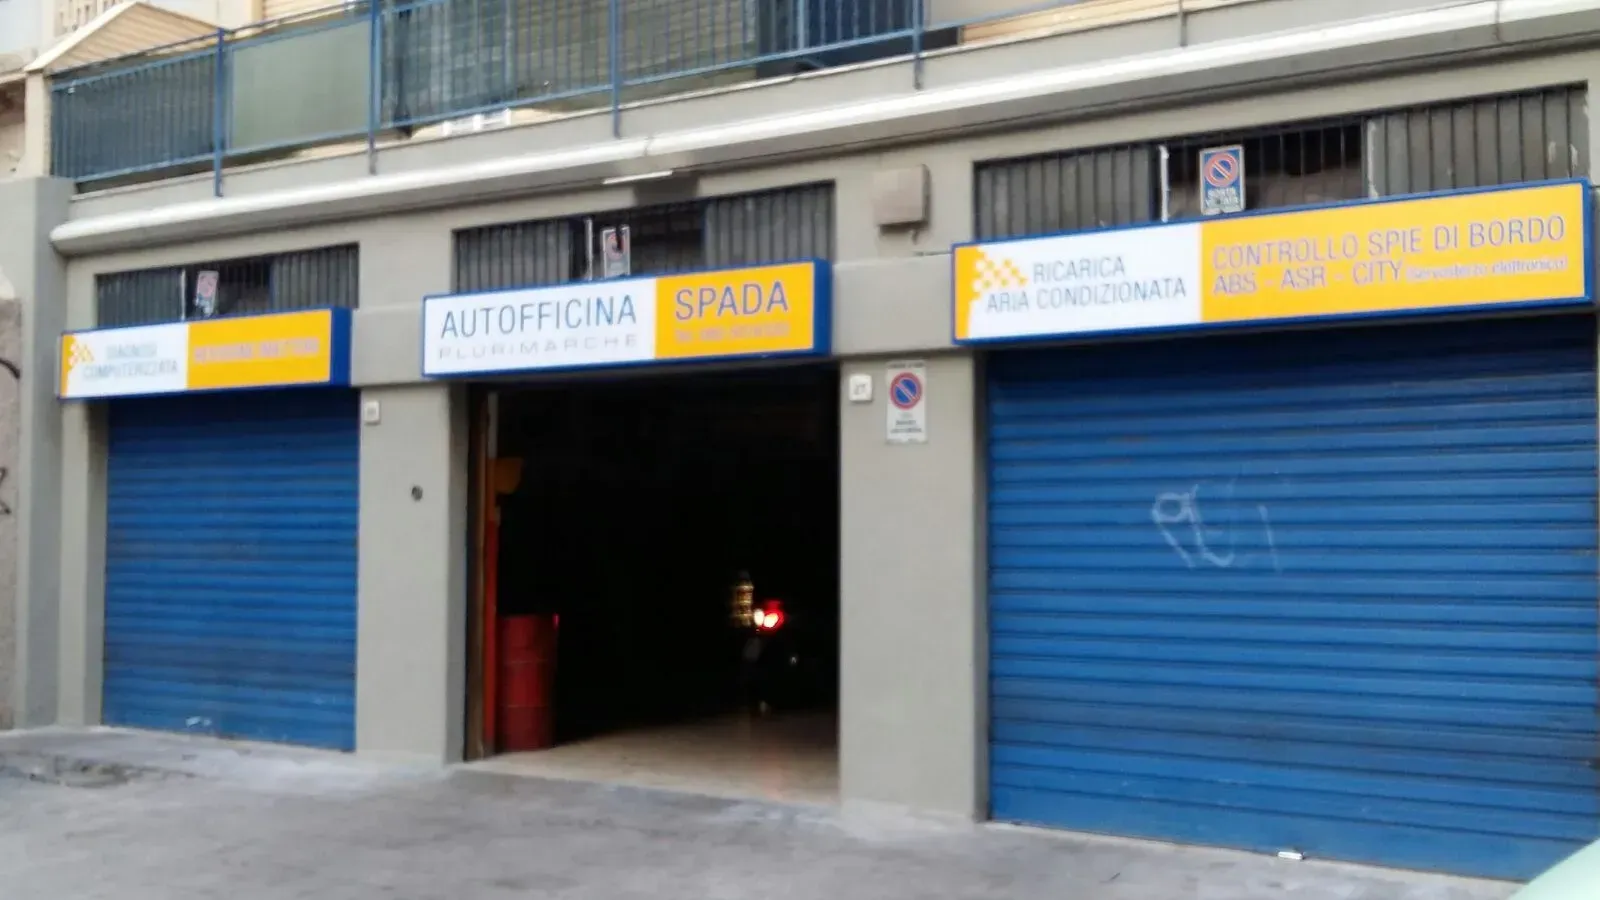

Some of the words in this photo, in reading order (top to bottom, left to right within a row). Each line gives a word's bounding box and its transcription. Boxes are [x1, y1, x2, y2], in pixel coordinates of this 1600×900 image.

[1212, 234, 1359, 270] CONTROLLO
[1367, 228, 1421, 257] SPIE
[1433, 223, 1458, 251] DI
[1469, 215, 1566, 247] BORDO
[1033, 255, 1126, 284] RICARICA
[1213, 271, 1257, 296] ABS
[1280, 266, 1326, 290] ASR
[1352, 260, 1404, 286] CITY
[674, 281, 789, 321] SPADA
[986, 290, 1029, 313] ARIA
[1035, 277, 1187, 310] CONDIZIONATA
[440, 294, 637, 339] AUTOFFICINA
[438, 334, 638, 360] PLURIMARCHE
